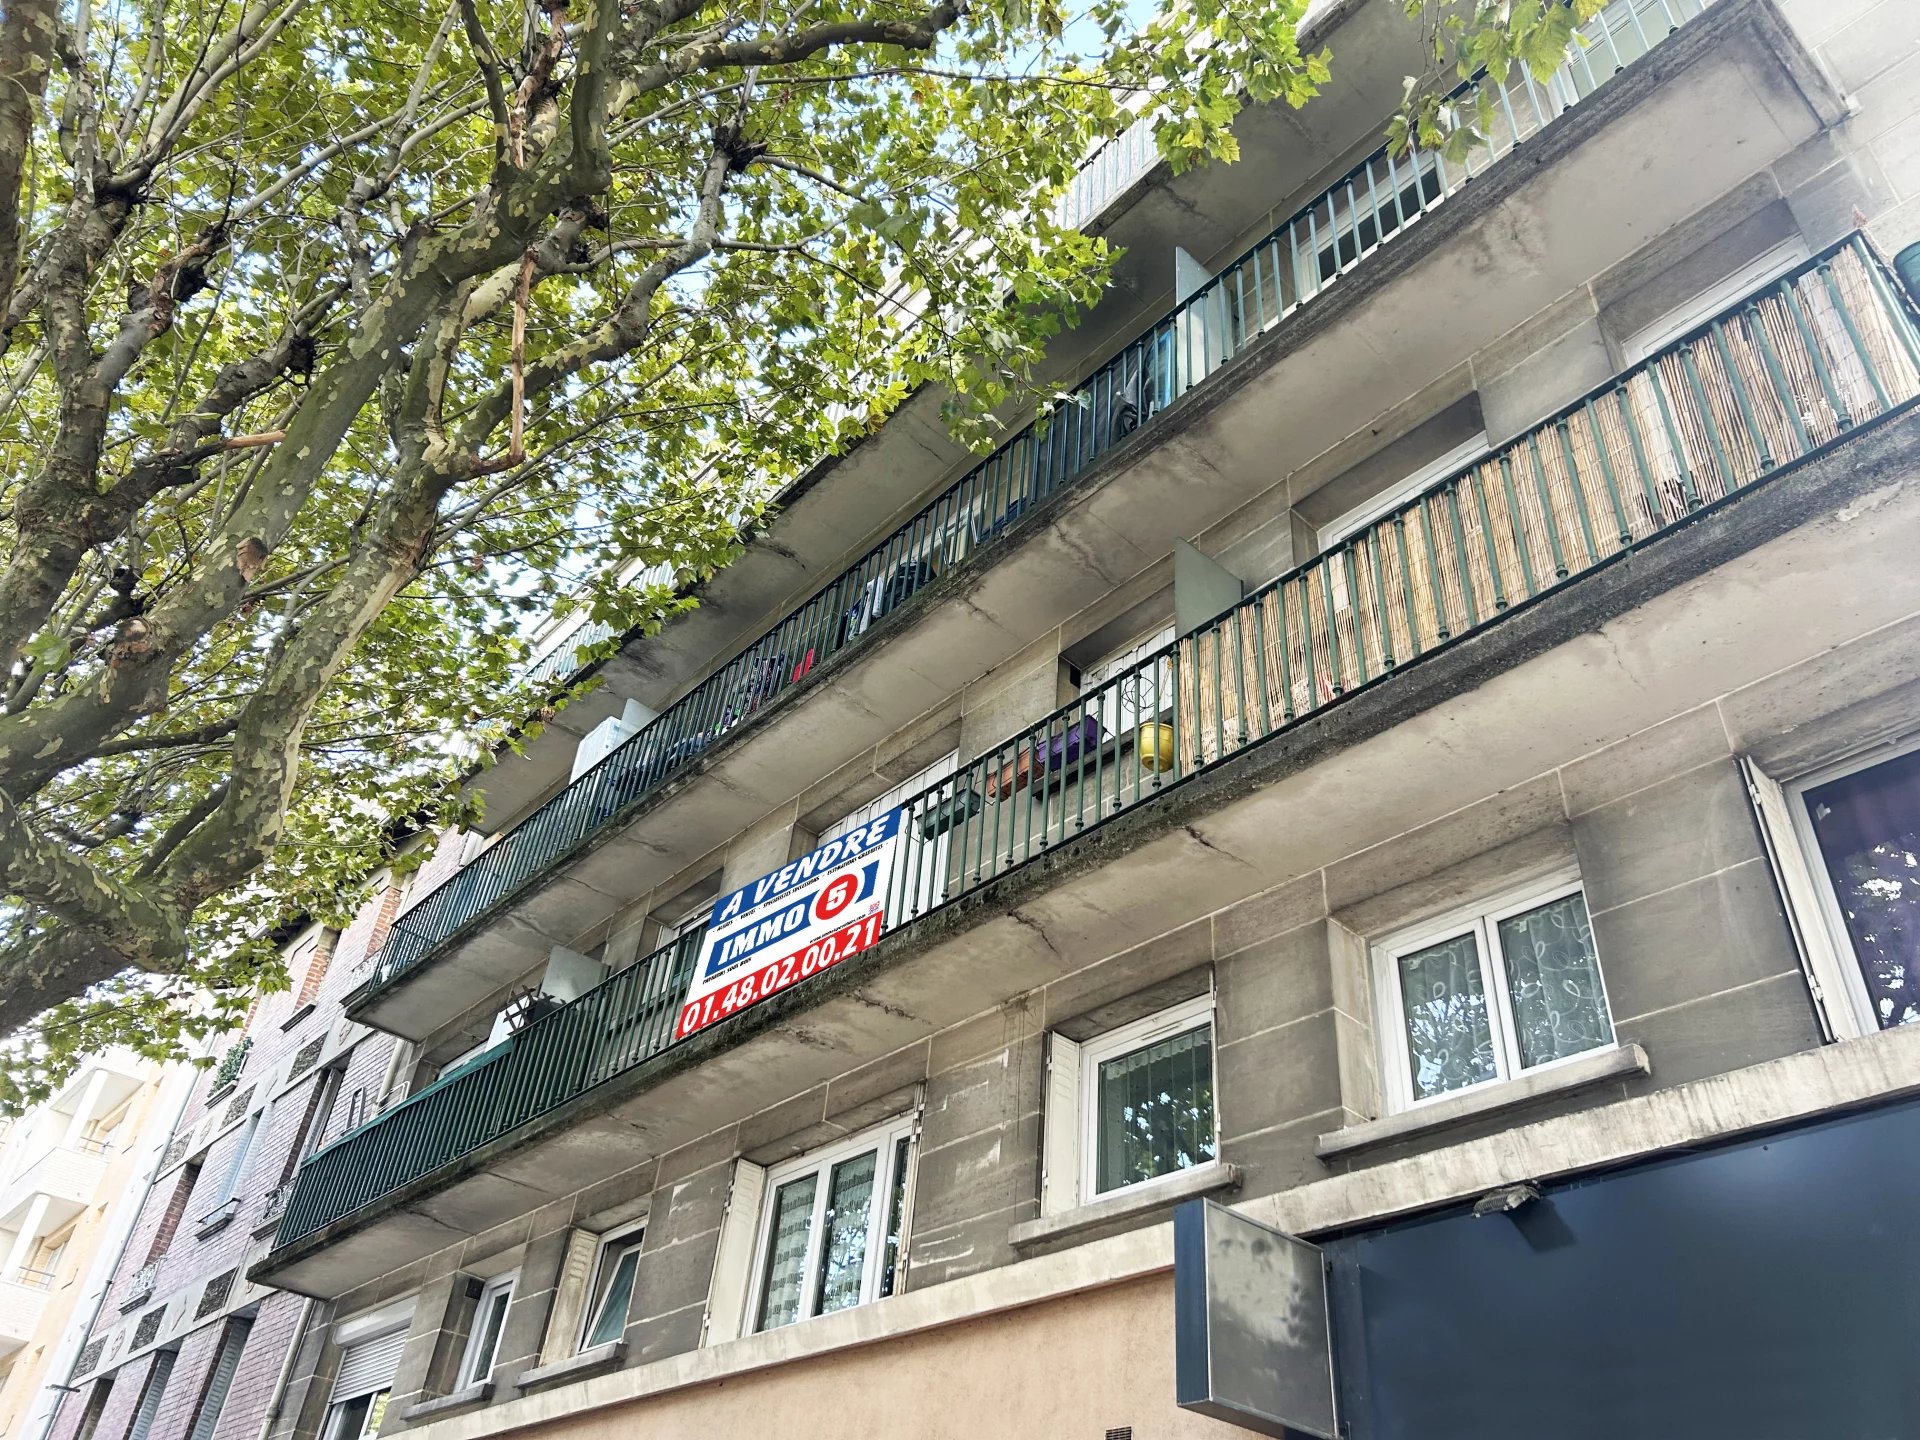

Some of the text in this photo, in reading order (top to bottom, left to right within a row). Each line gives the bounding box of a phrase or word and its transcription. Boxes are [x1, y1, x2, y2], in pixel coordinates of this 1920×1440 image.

[720, 815, 889, 921] A VENDRE
[683, 916, 876, 1033] 01.48.02.00.21
[718, 904, 805, 965] IMMO
[826, 882, 848, 910] 5
